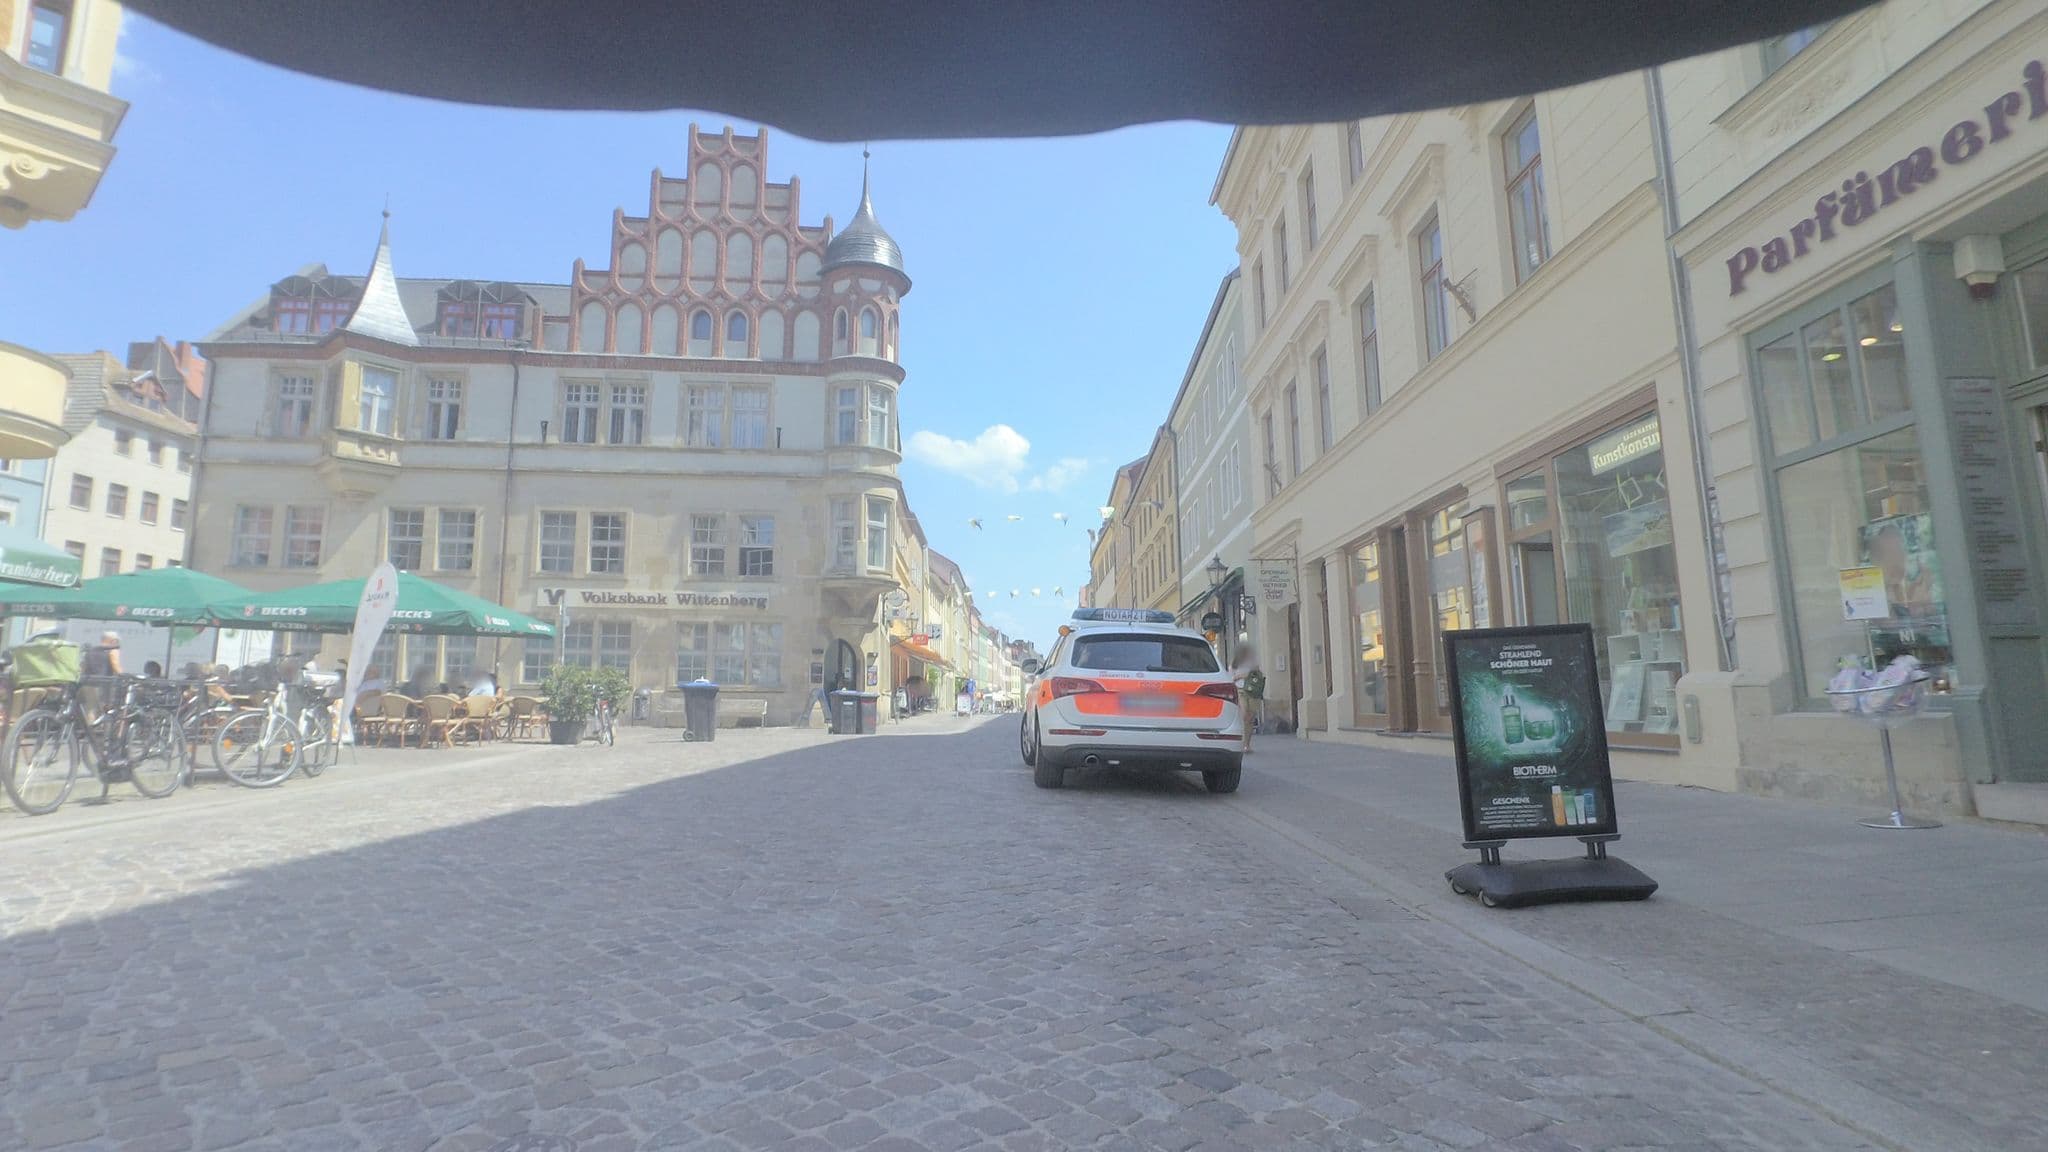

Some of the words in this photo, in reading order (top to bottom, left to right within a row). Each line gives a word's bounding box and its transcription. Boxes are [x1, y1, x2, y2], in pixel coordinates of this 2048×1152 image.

[580, 588, 668, 606] Volksbank
[677, 592, 768, 611] Wittenberg
[1513, 764, 1558, 775] BIOTHERM
